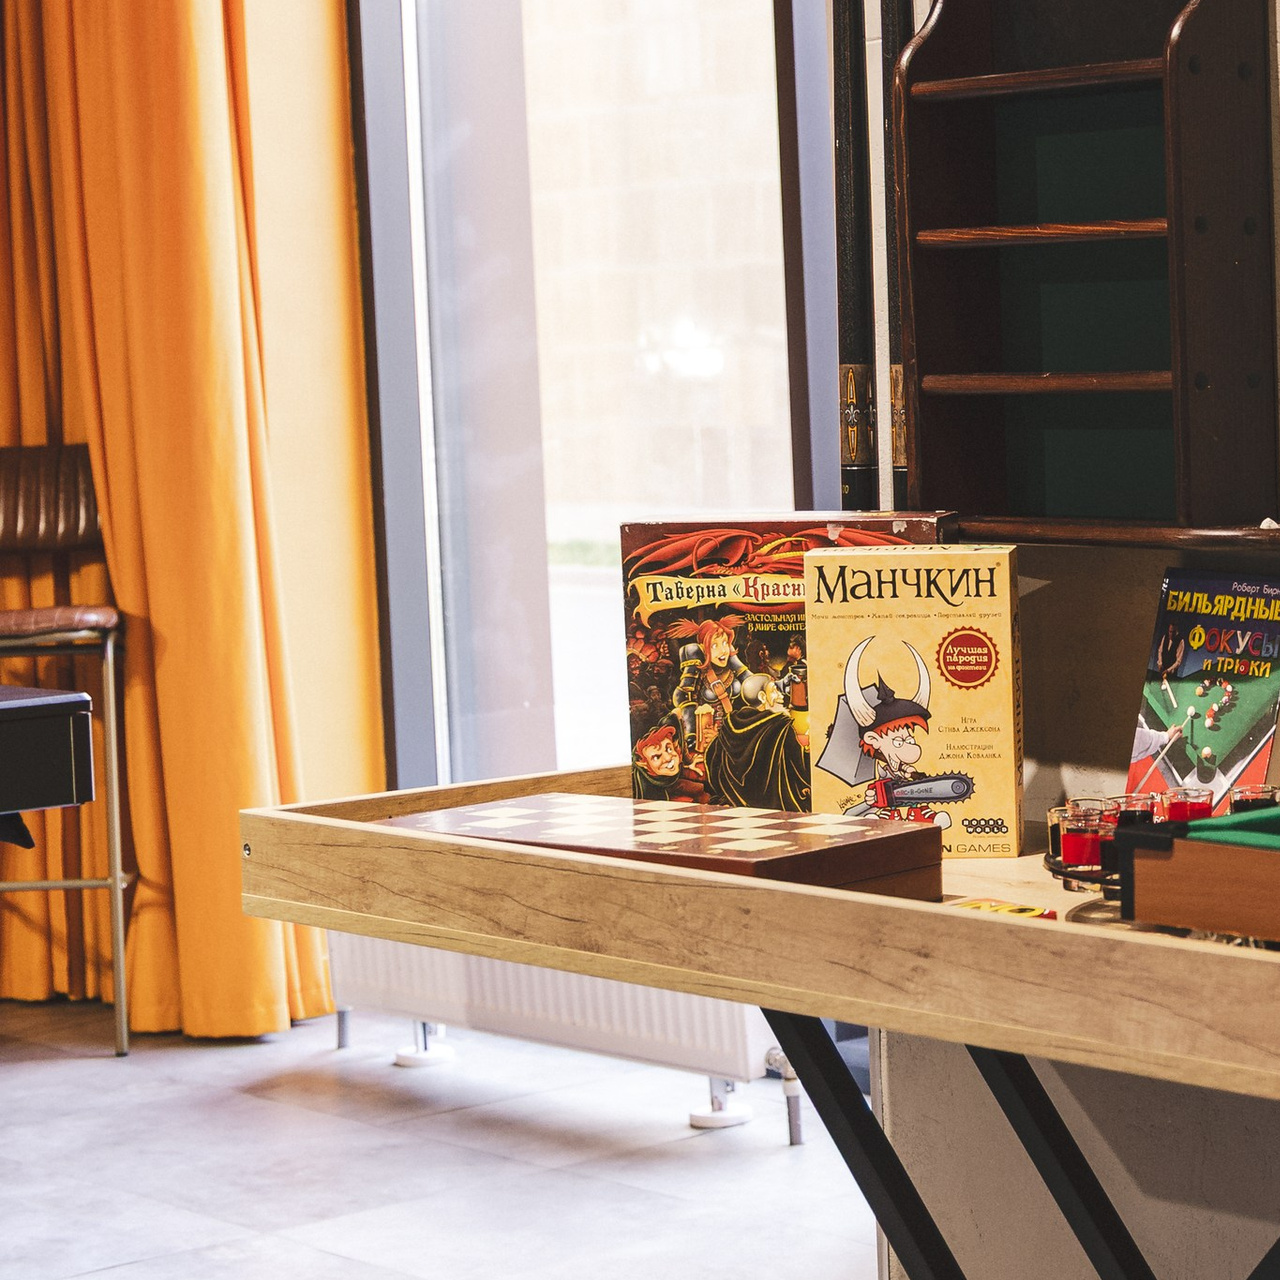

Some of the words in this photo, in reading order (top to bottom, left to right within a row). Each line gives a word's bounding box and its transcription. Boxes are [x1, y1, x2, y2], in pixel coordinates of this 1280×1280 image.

[646, 581, 727, 603] Таверна
[732, 576, 806, 602] «Красн
[814, 565, 997, 607] Манчкин
[1232, 582, 1260, 594] Роберт
[744, 613, 795, 622] ЗАСТОЛЬНАЯ
[748, 623, 753, 631] В
[754, 623, 776, 631] МИРЕ
[777, 623, 806, 631] ФЭНТЕ
[1188, 624, 1280, 659] ФОКУСЫ
[946, 645, 988, 655] Лучшая
[946, 654, 988, 664] пародия
[1217, 657, 1271, 678] ТРЮКИ
[957, 844, 1011, 853] GAMES
